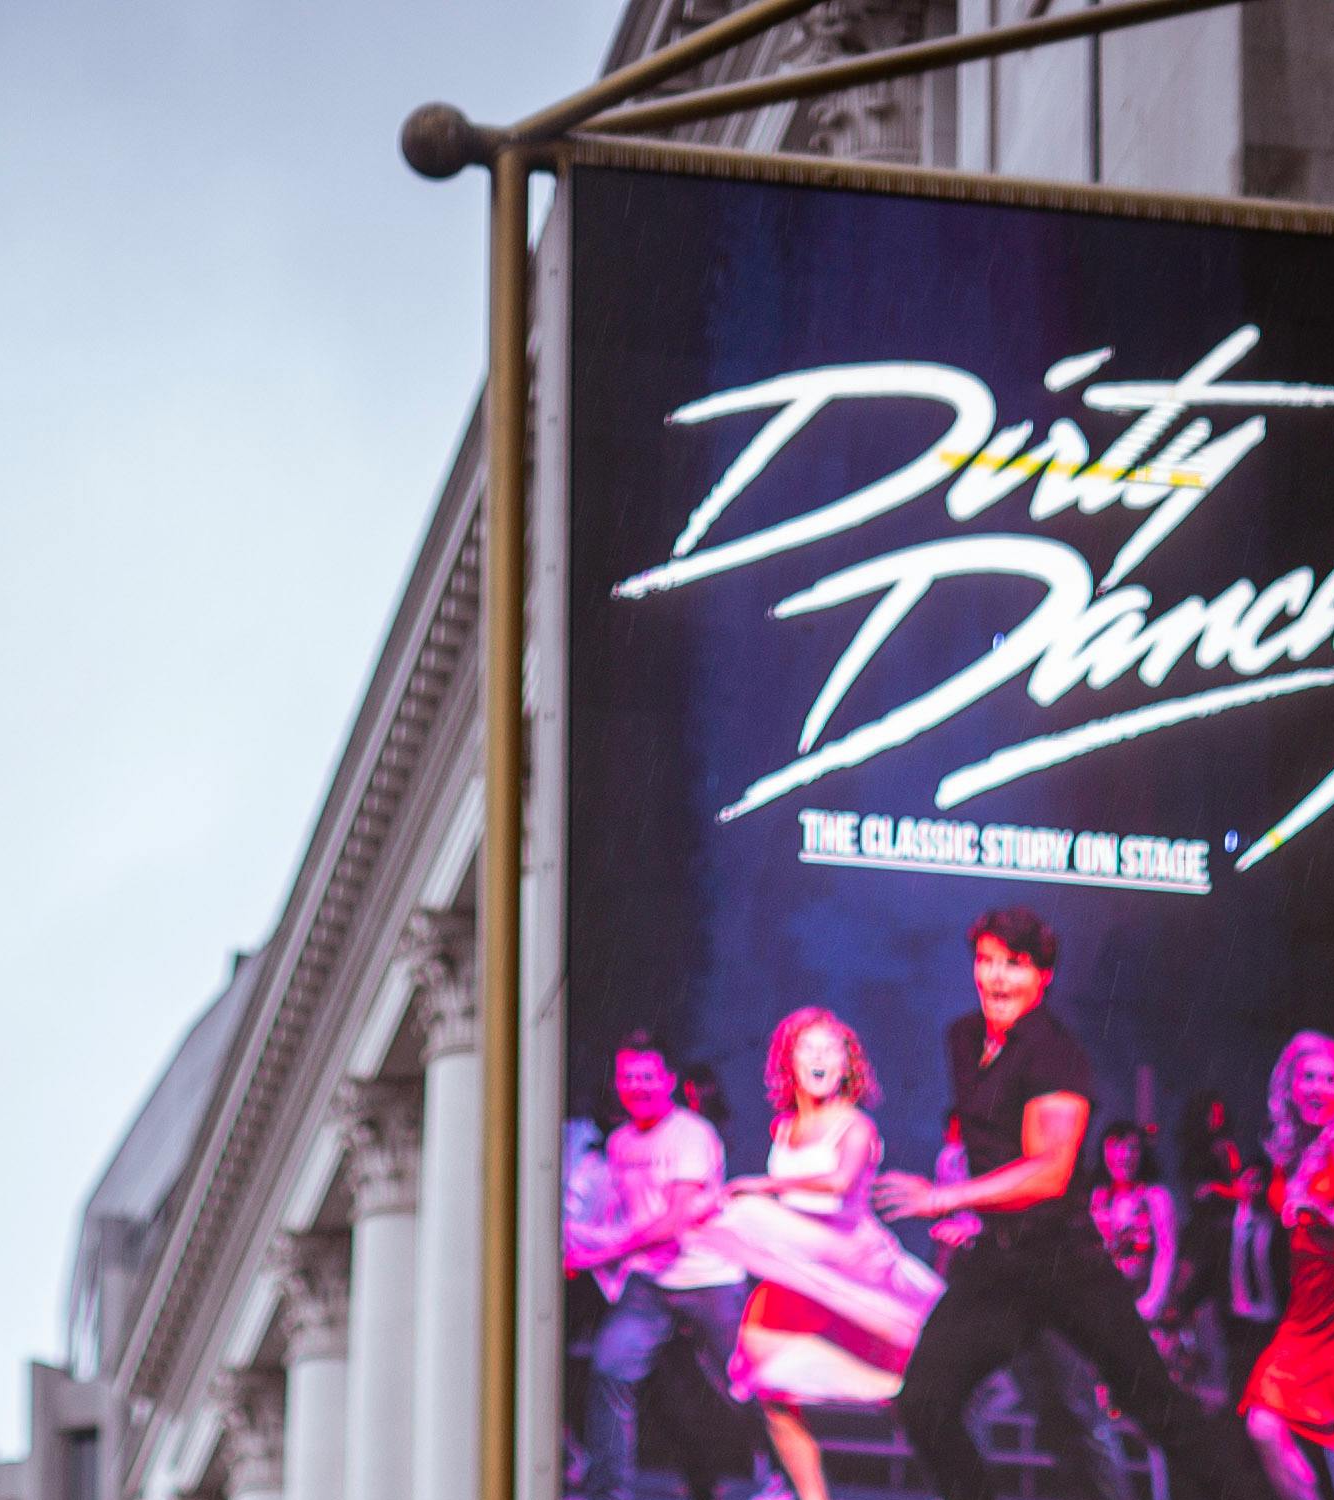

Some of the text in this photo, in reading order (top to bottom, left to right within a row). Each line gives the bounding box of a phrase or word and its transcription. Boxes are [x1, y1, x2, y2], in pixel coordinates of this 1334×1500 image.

[798, 808, 1211, 882] THE CLASSIC STORY ON STAGE
